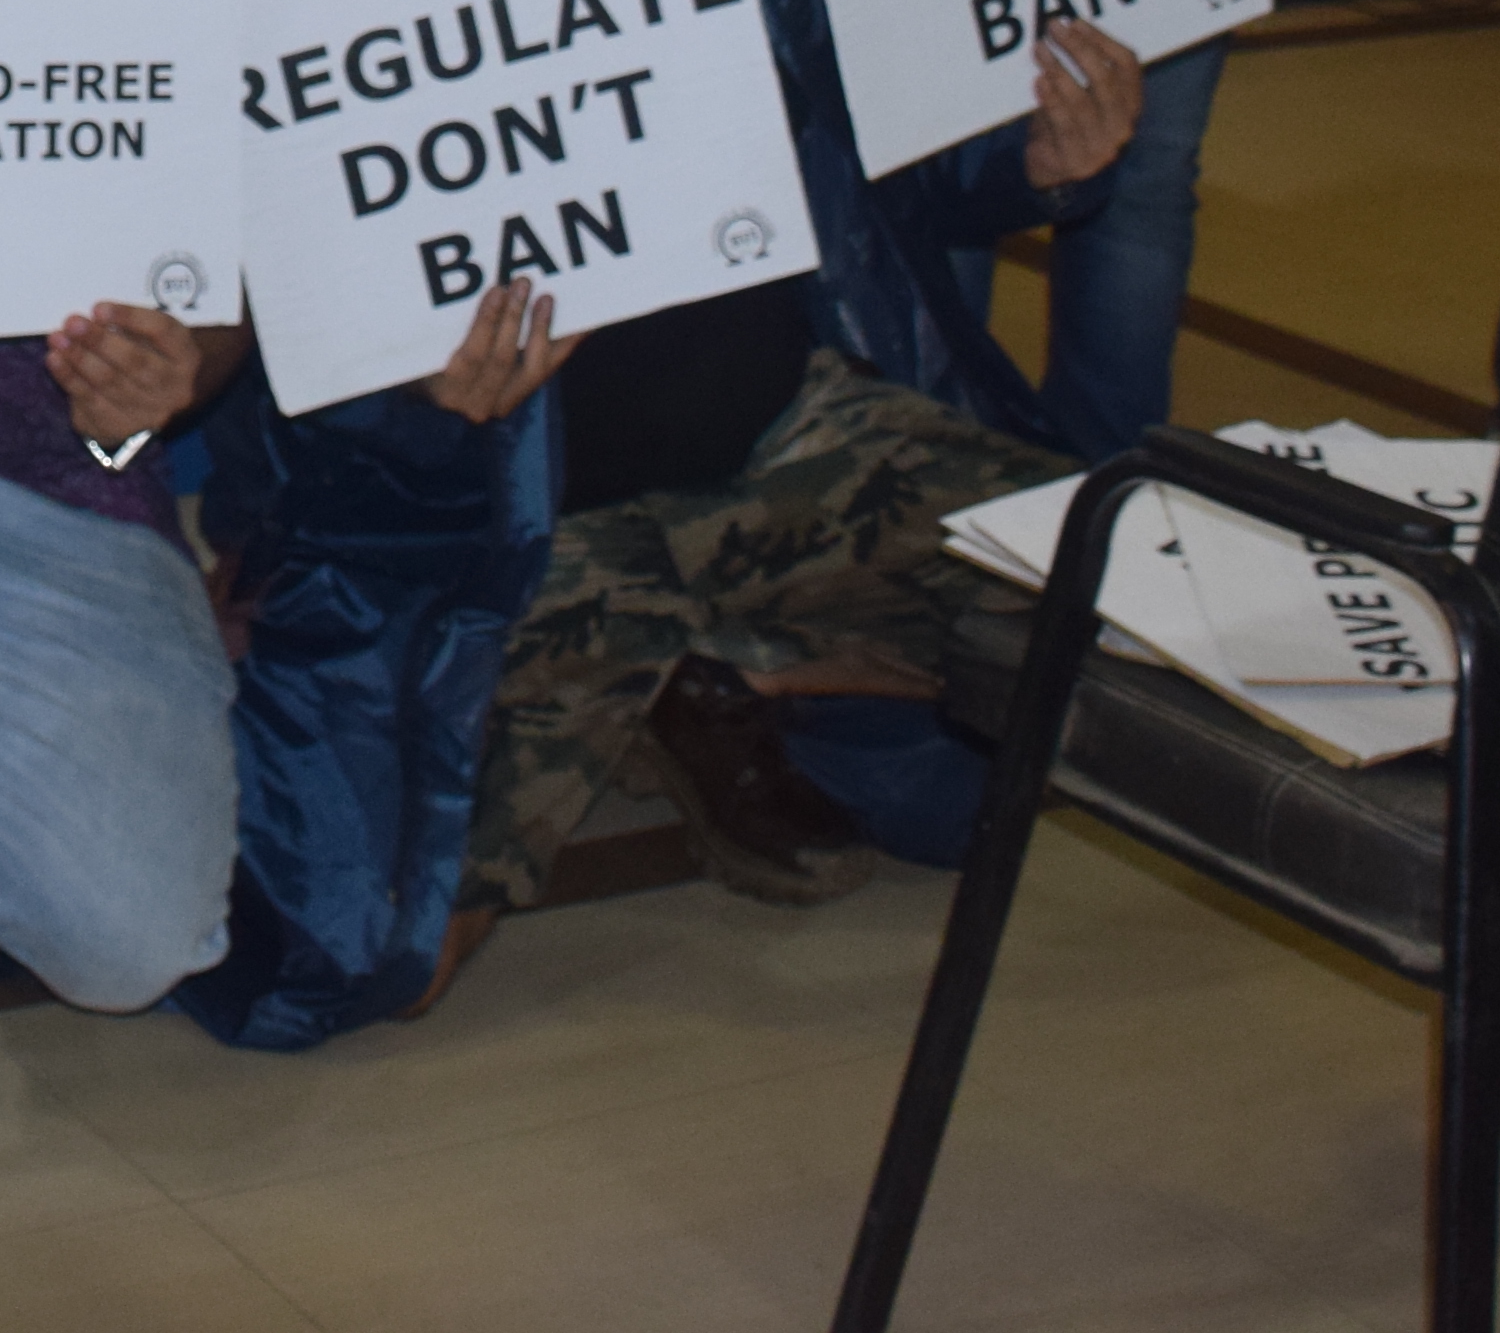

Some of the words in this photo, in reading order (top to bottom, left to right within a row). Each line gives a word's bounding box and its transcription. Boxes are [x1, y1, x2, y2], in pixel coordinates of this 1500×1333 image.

[341, 68, 654, 220] DON'T
[420, 189, 632, 308] BAN
[1328, 591, 1430, 680] SAVE
